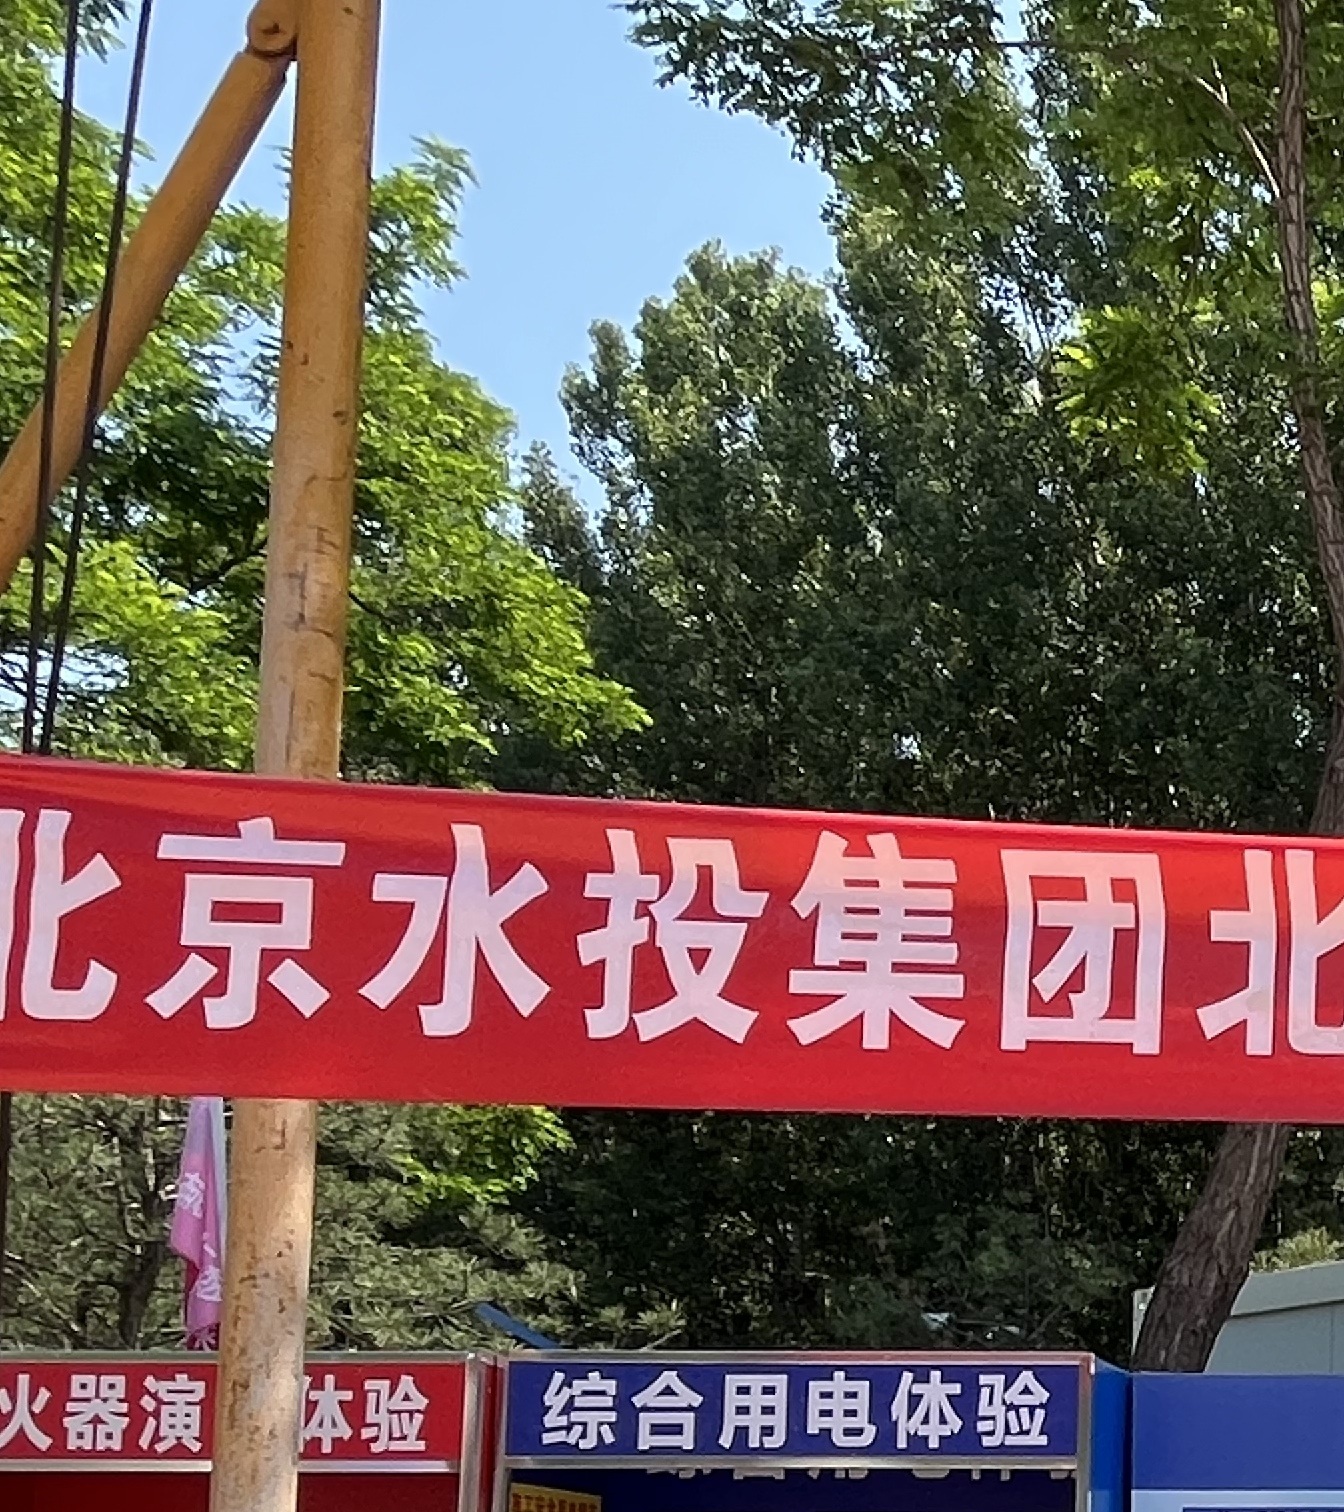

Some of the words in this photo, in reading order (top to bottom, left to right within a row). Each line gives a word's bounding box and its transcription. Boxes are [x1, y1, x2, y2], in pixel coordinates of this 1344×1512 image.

[0, 1374, 429, 1454] 火器演体验
[541, 1370, 1051, 1450] 综合用电体验
